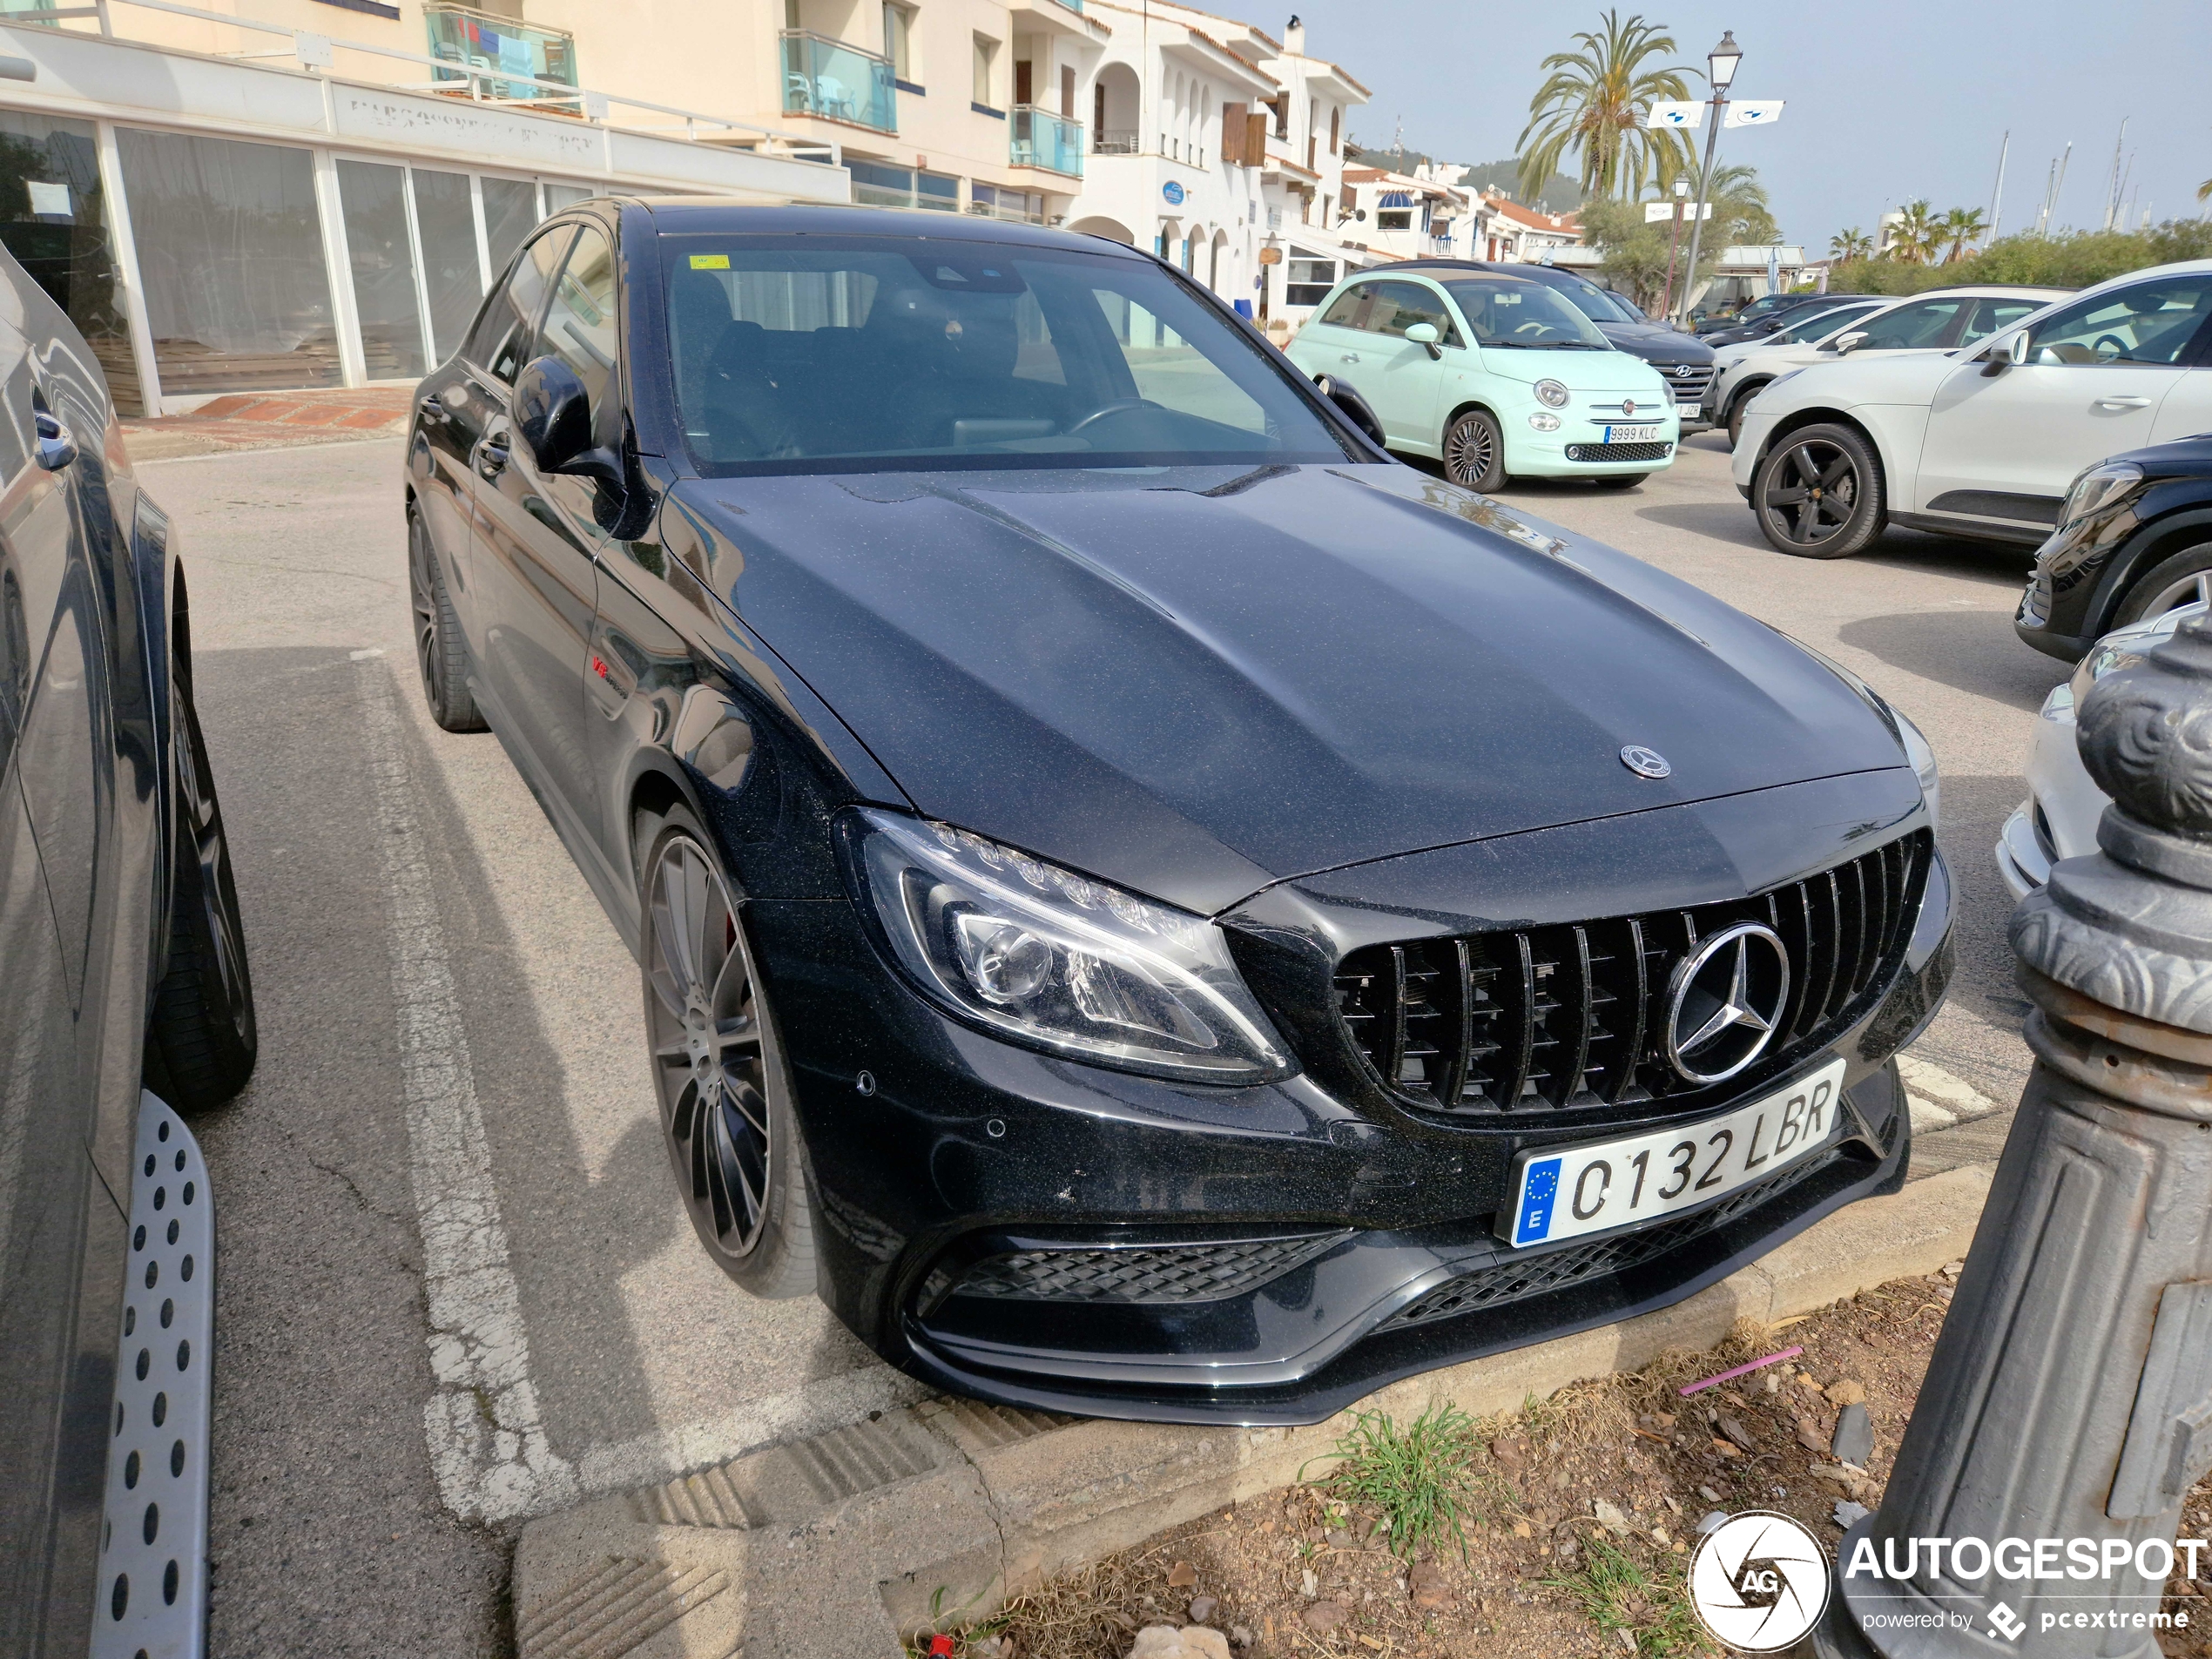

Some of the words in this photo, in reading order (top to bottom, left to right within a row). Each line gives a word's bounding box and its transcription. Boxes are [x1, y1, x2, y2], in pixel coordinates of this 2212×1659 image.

[1684, 405, 1699, 415] JZR
[1611, 428, 1636, 441] 9999
[1639, 427, 1656, 440] KLC
[1571, 1129, 1734, 1221] 0132
[1743, 1079, 1832, 1171] LBR
[1528, 1210, 1543, 1228] E
